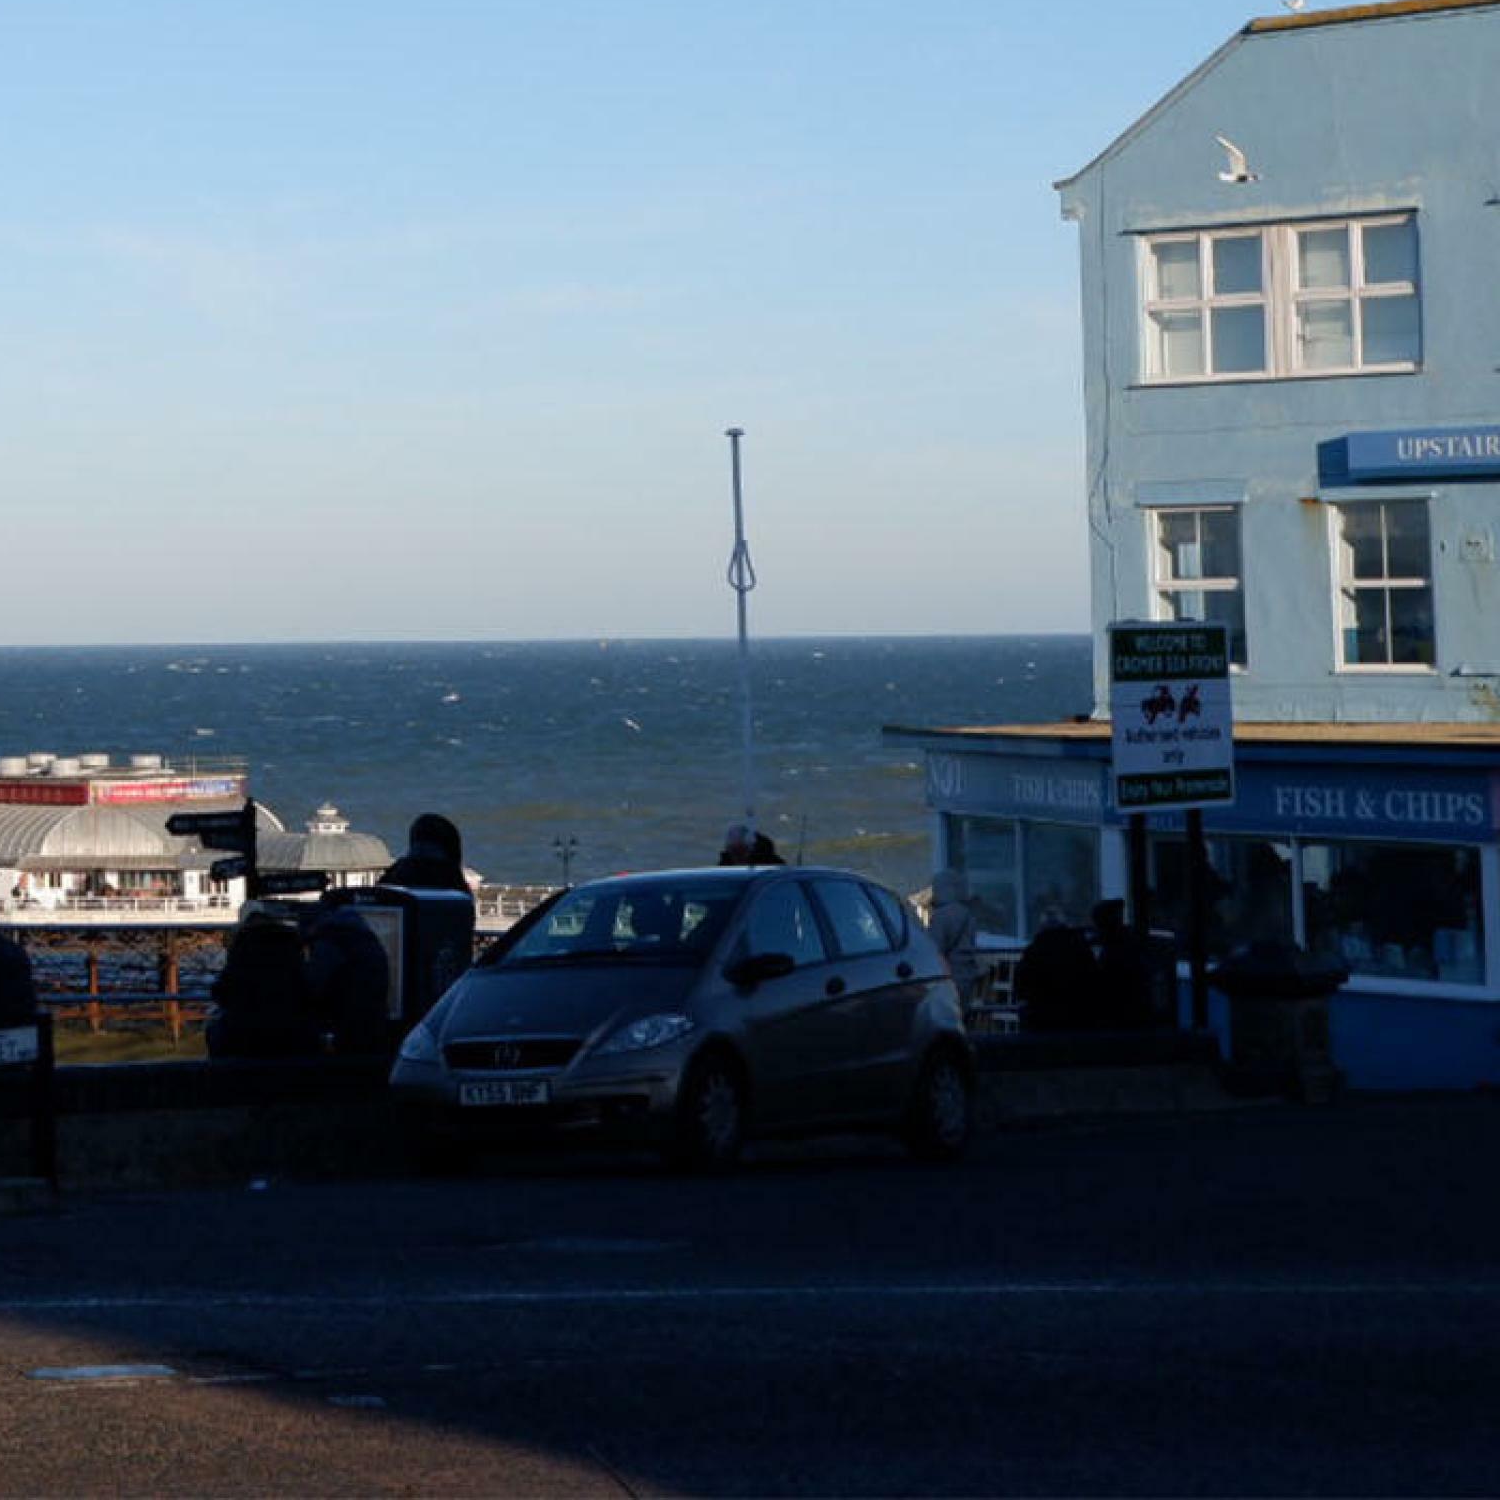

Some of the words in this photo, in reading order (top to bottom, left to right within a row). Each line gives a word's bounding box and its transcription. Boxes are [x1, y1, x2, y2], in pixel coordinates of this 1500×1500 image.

[1398, 435, 1500, 460] UPSTAIR
[1275, 786, 1347, 818] FISH
[1355, 789, 1376, 820] &
[1384, 790, 1485, 826] CHIPS
